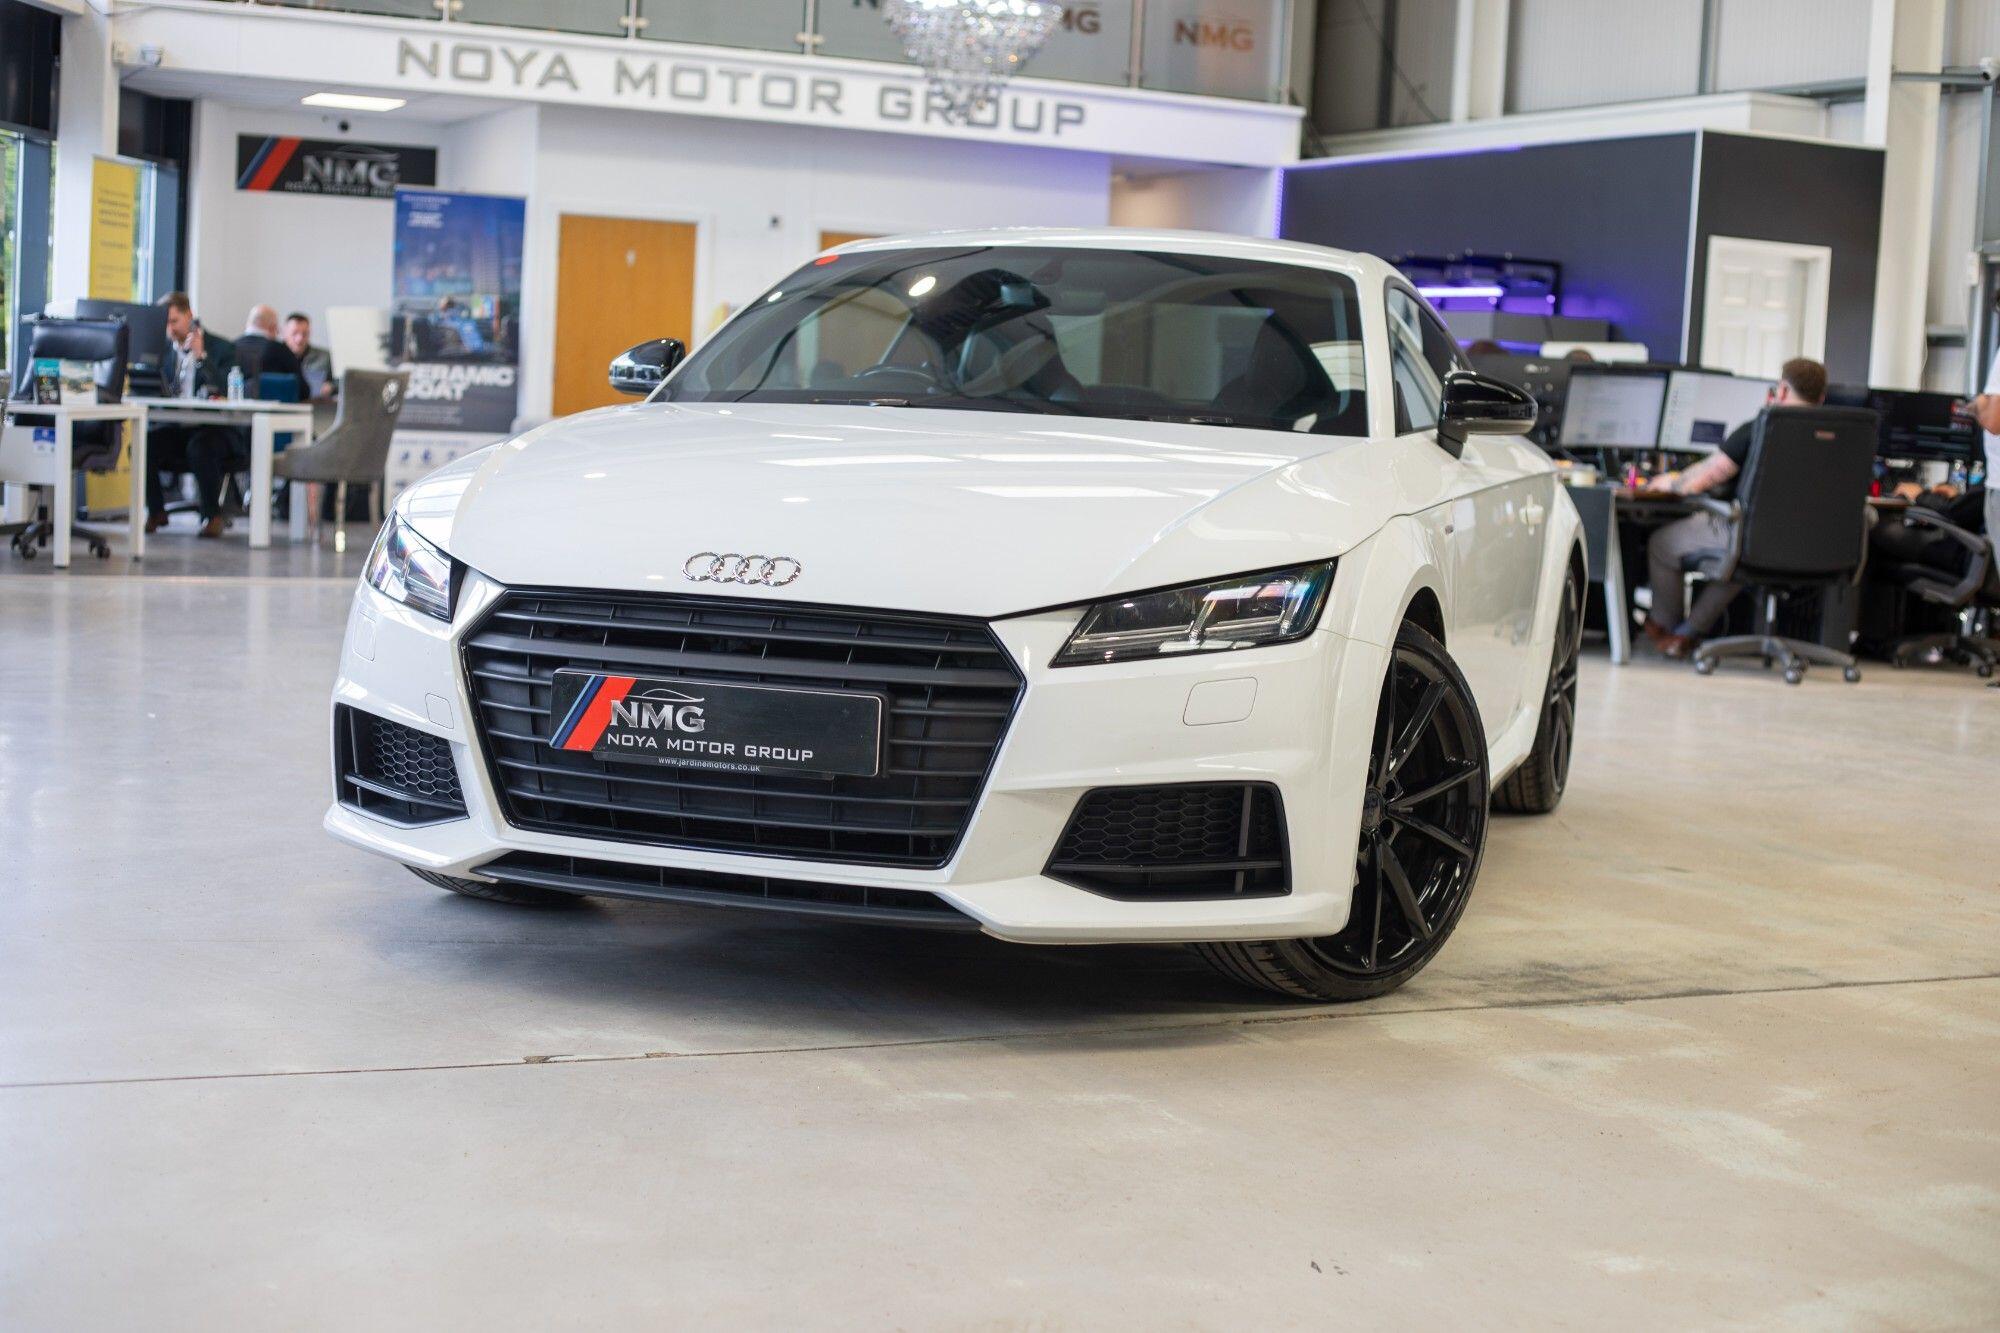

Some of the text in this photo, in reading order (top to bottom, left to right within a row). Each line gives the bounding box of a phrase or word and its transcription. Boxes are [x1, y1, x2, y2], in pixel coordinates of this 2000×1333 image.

[1174, 19, 1254, 52] NMG
[397, 37, 1085, 135] NOYA MOTOR GROUP
[302, 154, 399, 187] NMG
[609, 699, 705, 733] NMG
[607, 733, 813, 762] NOYA MOTOR GROUP
[658, 757, 760, 772] www.jardinemotors.co.uk
